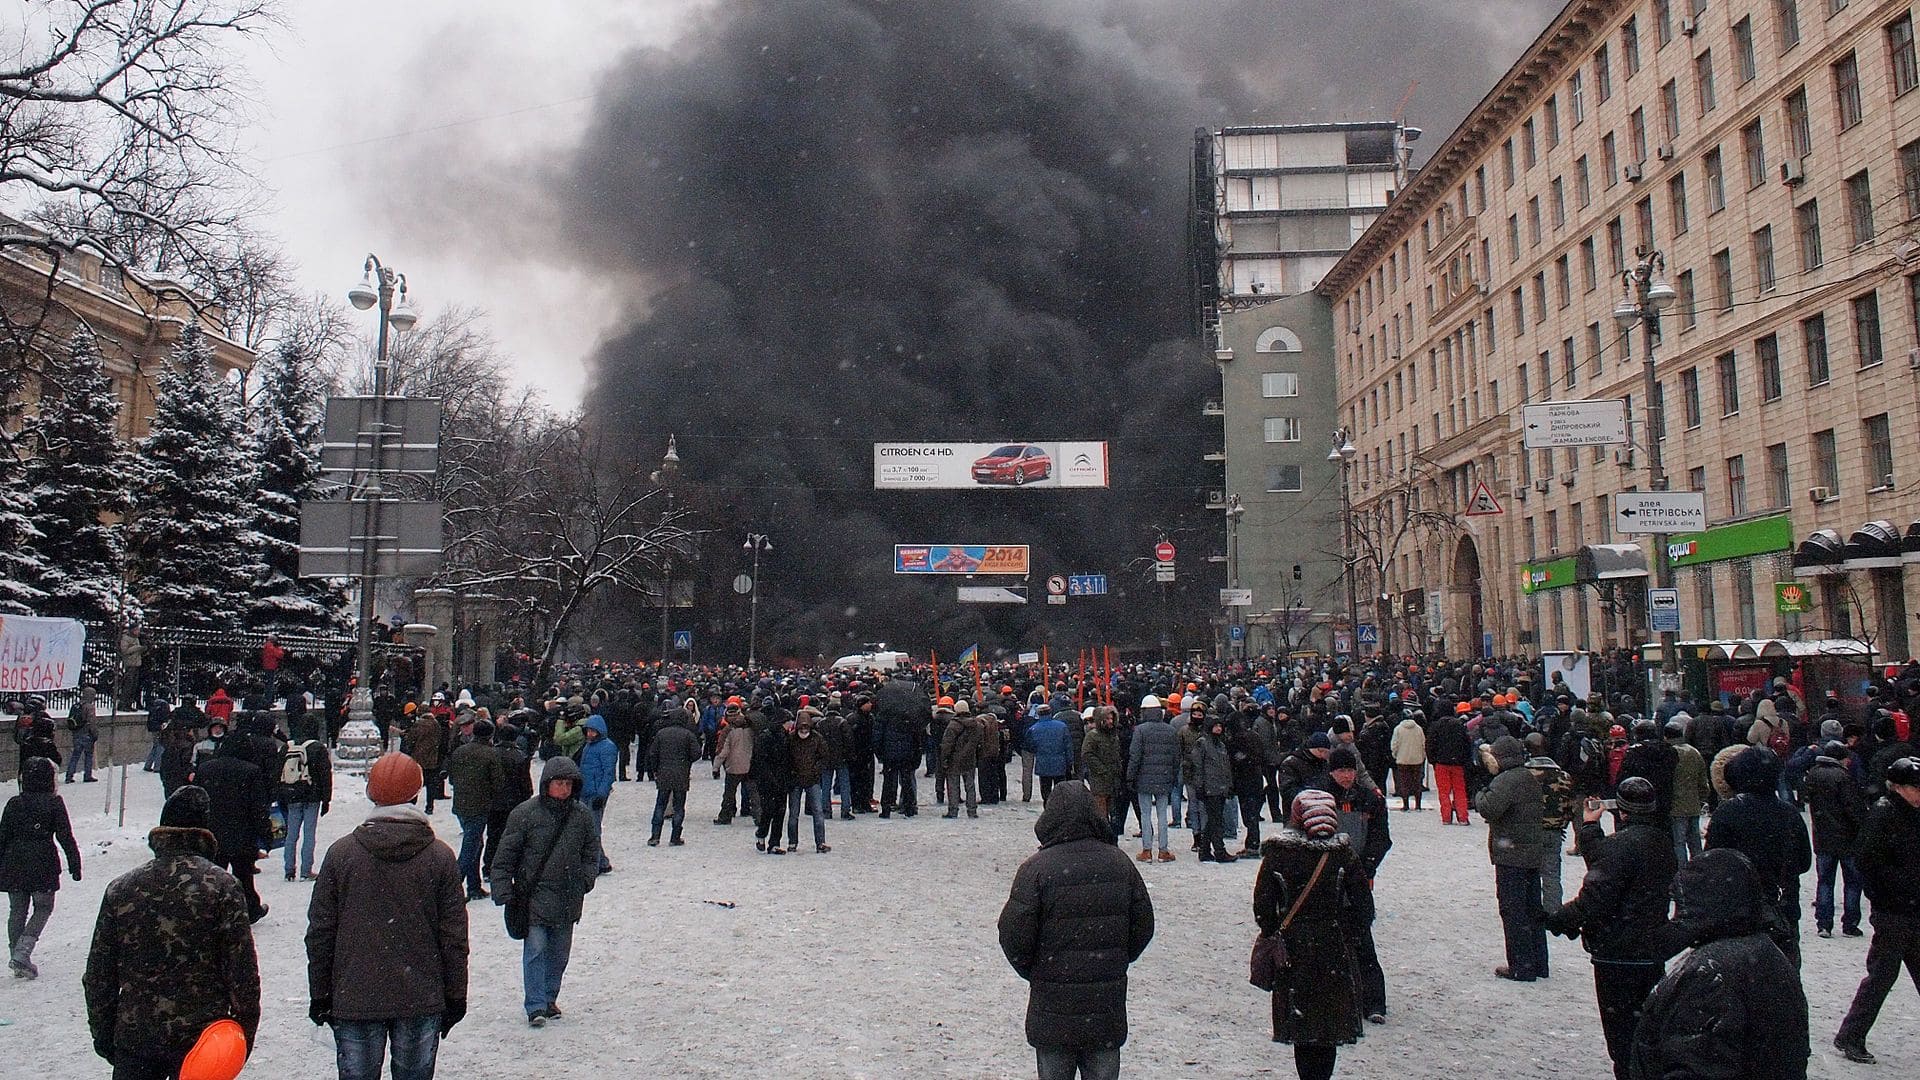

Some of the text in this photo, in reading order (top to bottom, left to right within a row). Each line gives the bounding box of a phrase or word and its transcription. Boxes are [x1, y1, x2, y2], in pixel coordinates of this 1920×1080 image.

[1551, 422, 1601, 431] ДНІПРОВСЬКИЙ
[923, 448, 935, 456] C4
[1639, 508, 1701, 517] ПЕТРІВСЬКА
[985, 549, 1024, 561] 2014
[0, 635, 41, 662] АШУ
[0, 662, 65, 690] ВОБОДУ
